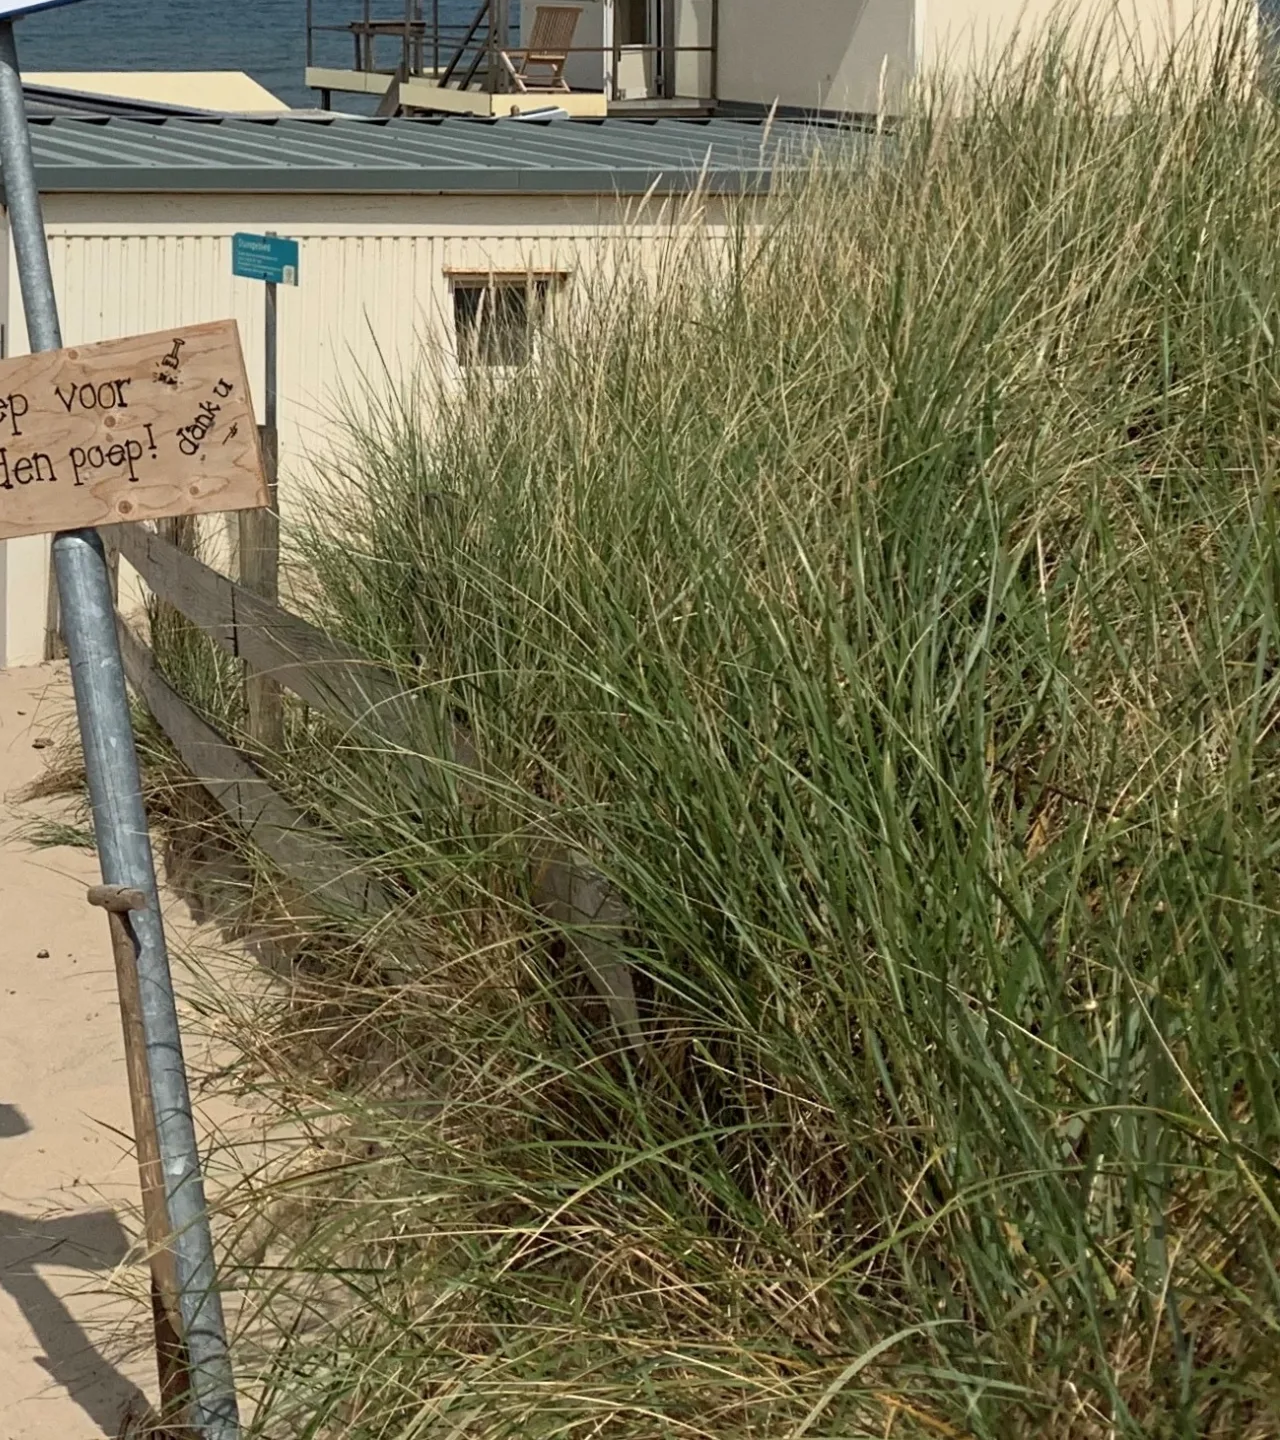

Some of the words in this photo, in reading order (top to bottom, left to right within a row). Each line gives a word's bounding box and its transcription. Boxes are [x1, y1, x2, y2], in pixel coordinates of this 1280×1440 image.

[54, 377, 132, 413] voor
[175, 400, 222, 456] dank
[212, 377, 234, 398] u
[68, 422, 158, 486] poep!
